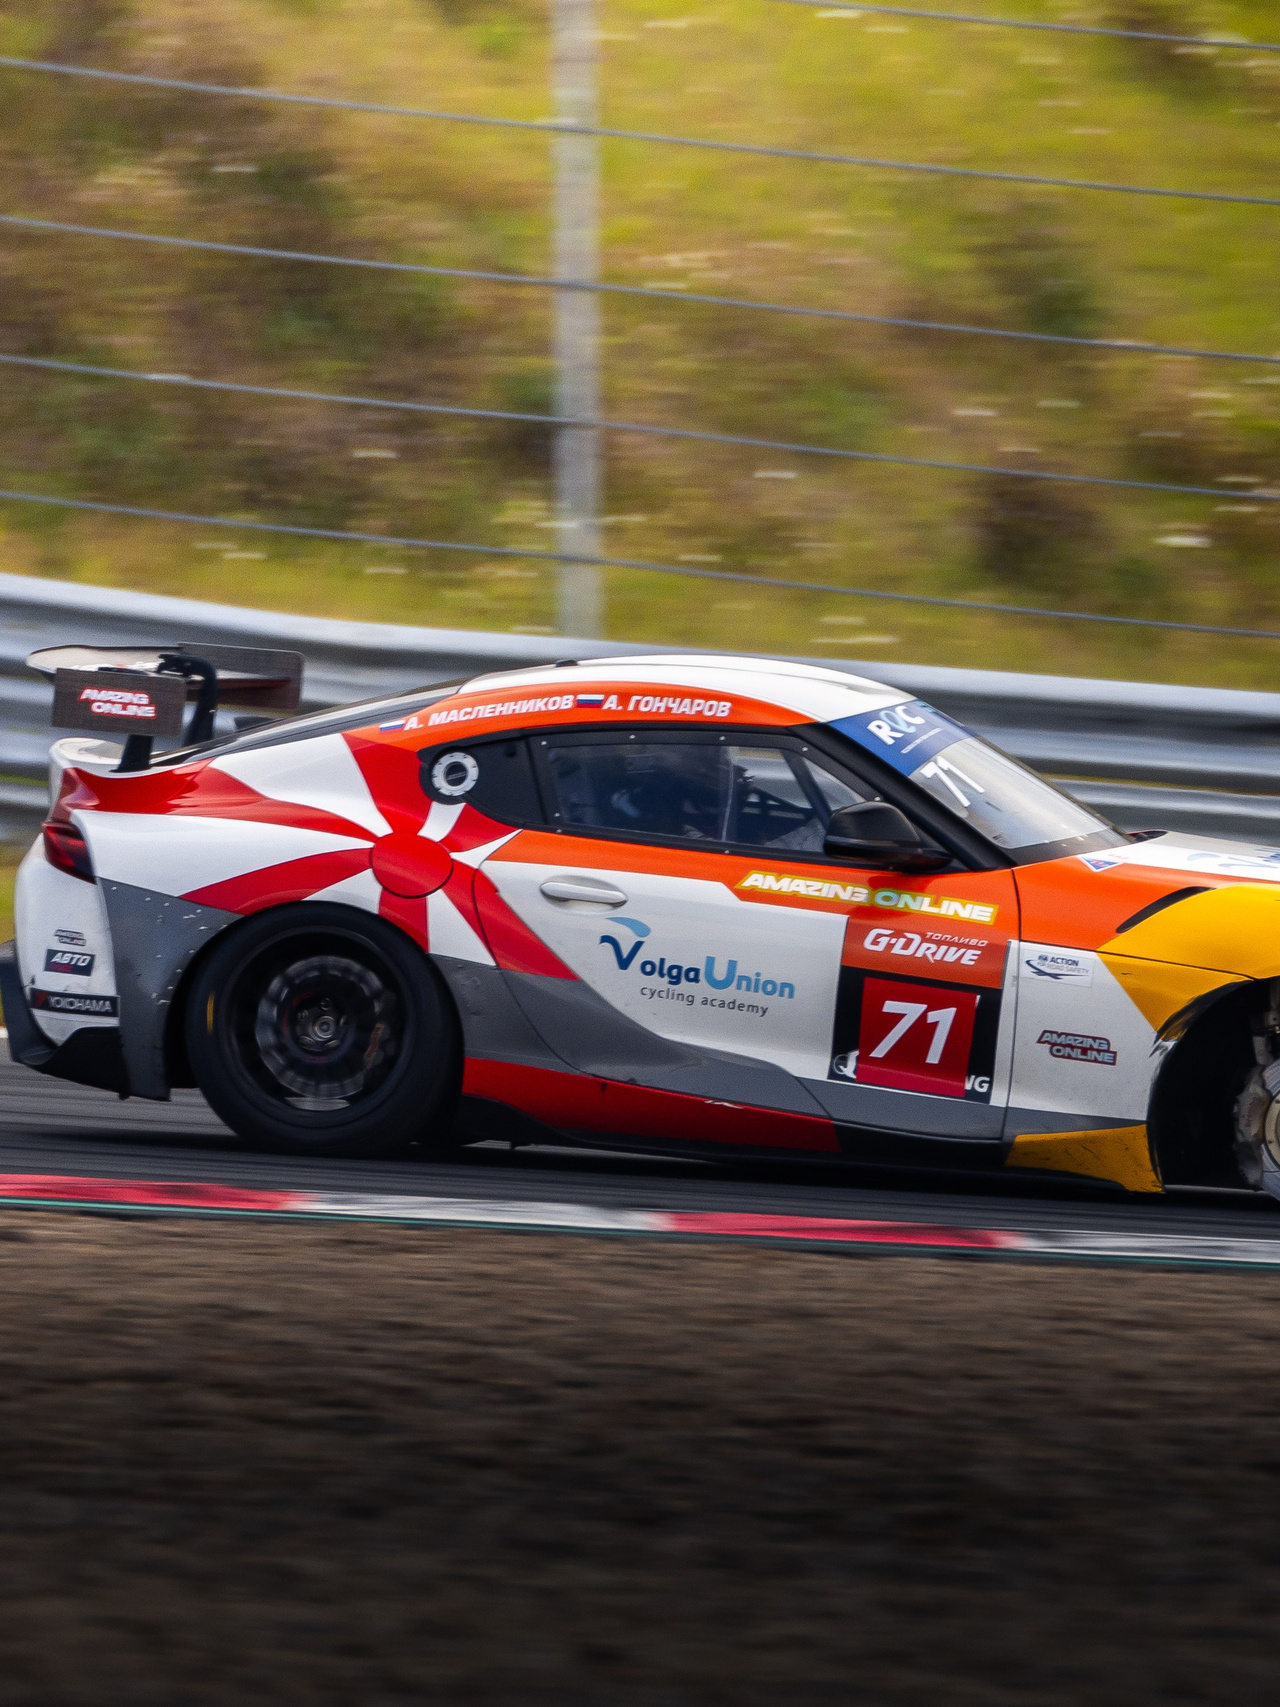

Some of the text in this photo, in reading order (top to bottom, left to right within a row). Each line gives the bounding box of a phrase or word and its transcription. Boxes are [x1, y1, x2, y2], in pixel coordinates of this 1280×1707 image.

[92, 702, 156, 717] ONLINE
[404, 694, 574, 731] А. МАСЛЕННИКОВ
[602, 695, 732, 718] А. ГОНЧАРОВ
[920, 756, 985, 807] 71
[743, 873, 994, 922] AMAZING ONLINE
[50, 952, 92, 966] АВТО
[1050, 956, 1079, 967] ACTION
[640, 986, 768, 1018] cycling academy
[869, 1000, 957, 1065] 71
[1041, 1032, 1109, 1050] AMAZING
[1052, 1046, 1115, 1063] ONLINE
